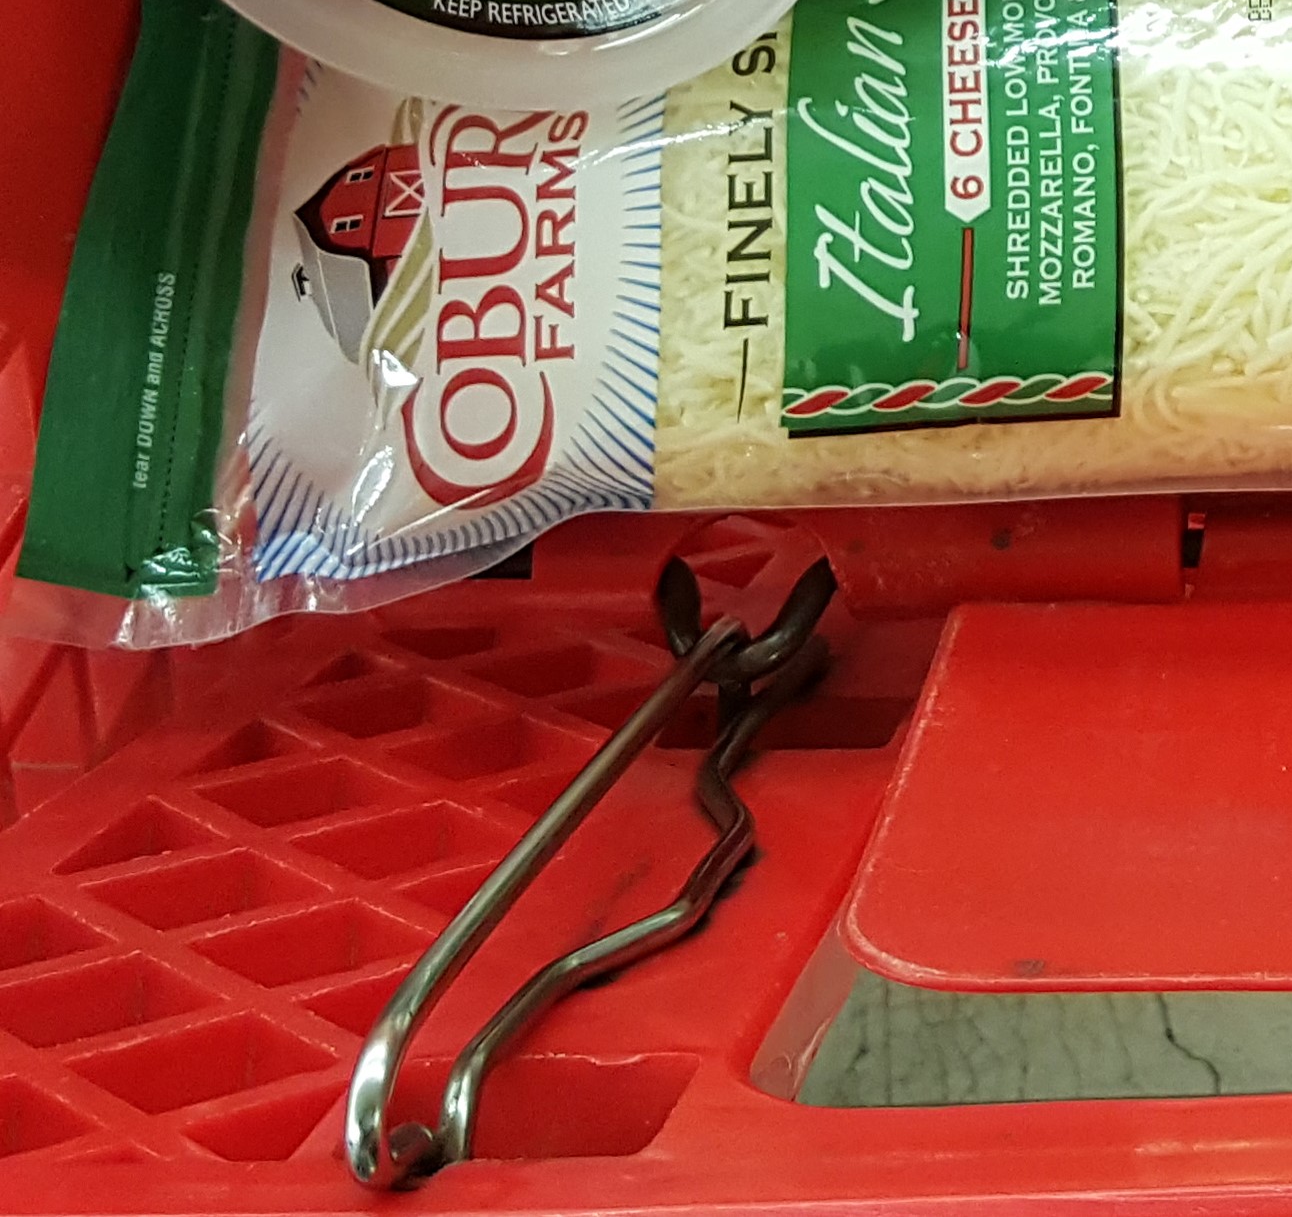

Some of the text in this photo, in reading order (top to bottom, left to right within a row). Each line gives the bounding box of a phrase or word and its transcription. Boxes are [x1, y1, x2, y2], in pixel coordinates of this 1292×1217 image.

[533, 109, 590, 362] FARMS
[723, 100, 773, 330] FINELY
[797, 16, 920, 342] Italian
[950, 173, 986, 201] 6
[1006, 125, 1031, 300] SHREDDED
[1038, 93, 1066, 306] MOZZARELLA,
[1072, 143, 1101, 289] ROMANO,
[146, 350, 165, 386] and
[150, 272, 177, 348] ACROSS
[402, 104, 557, 510] COBUR
[136, 387, 160, 447] DOWN
